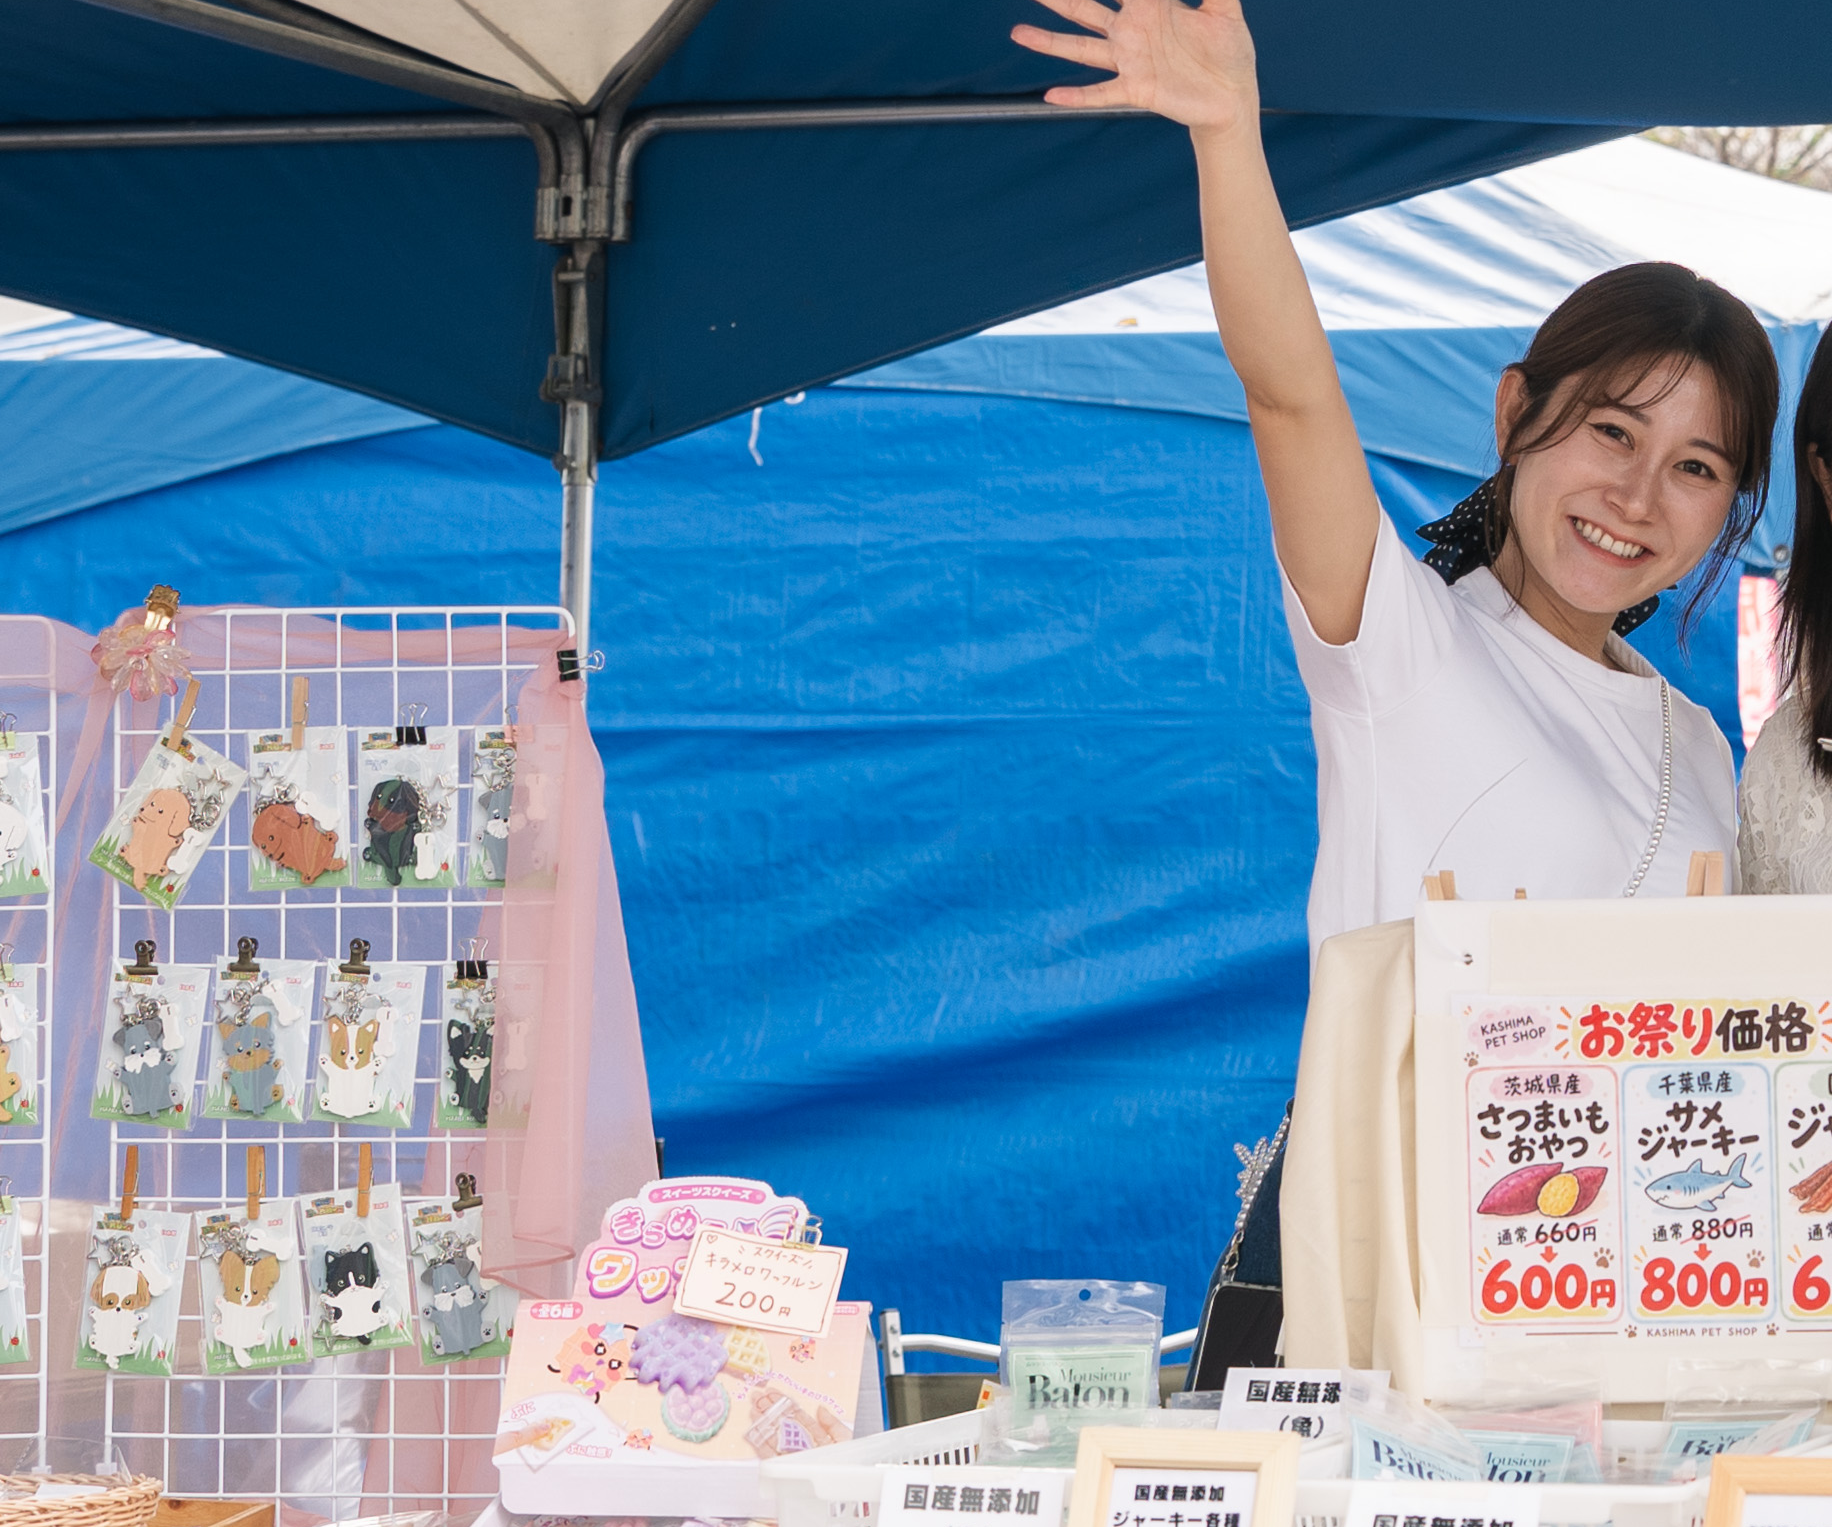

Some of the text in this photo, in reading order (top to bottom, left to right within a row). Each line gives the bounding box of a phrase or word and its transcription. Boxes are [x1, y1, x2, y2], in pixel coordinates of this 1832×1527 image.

[1480, 1015, 1533, 1036] KASHIMA
[1485, 1026, 1547, 1050] PET SHOP
[1579, 1001, 1815, 1059] お祭り価格
[1504, 1073, 1582, 1097] 茨城県産
[1659, 1071, 1734, 1095] 千葉県産
[1477, 1100, 1610, 1140] さつまいも
[1666, 1101, 1724, 1127] サメ
[1508, 1133, 1589, 1164] おやつ
[1638, 1127, 1760, 1162] ジャーキー
[661, 1186, 753, 1201] スイーツスクイーズ
[610, 1205, 728, 1248] きらめ
[715, 1281, 791, 1316] 200円
[1482, 1259, 1616, 1315] 600円
[1640, 1257, 1769, 1311] 800円
[1647, 1326, 1758, 1338] KASHIMA PET SHOP
[903, 1484, 1040, 1515] 国産無添加
[1134, 1484, 1226, 1502] 国産無添加
